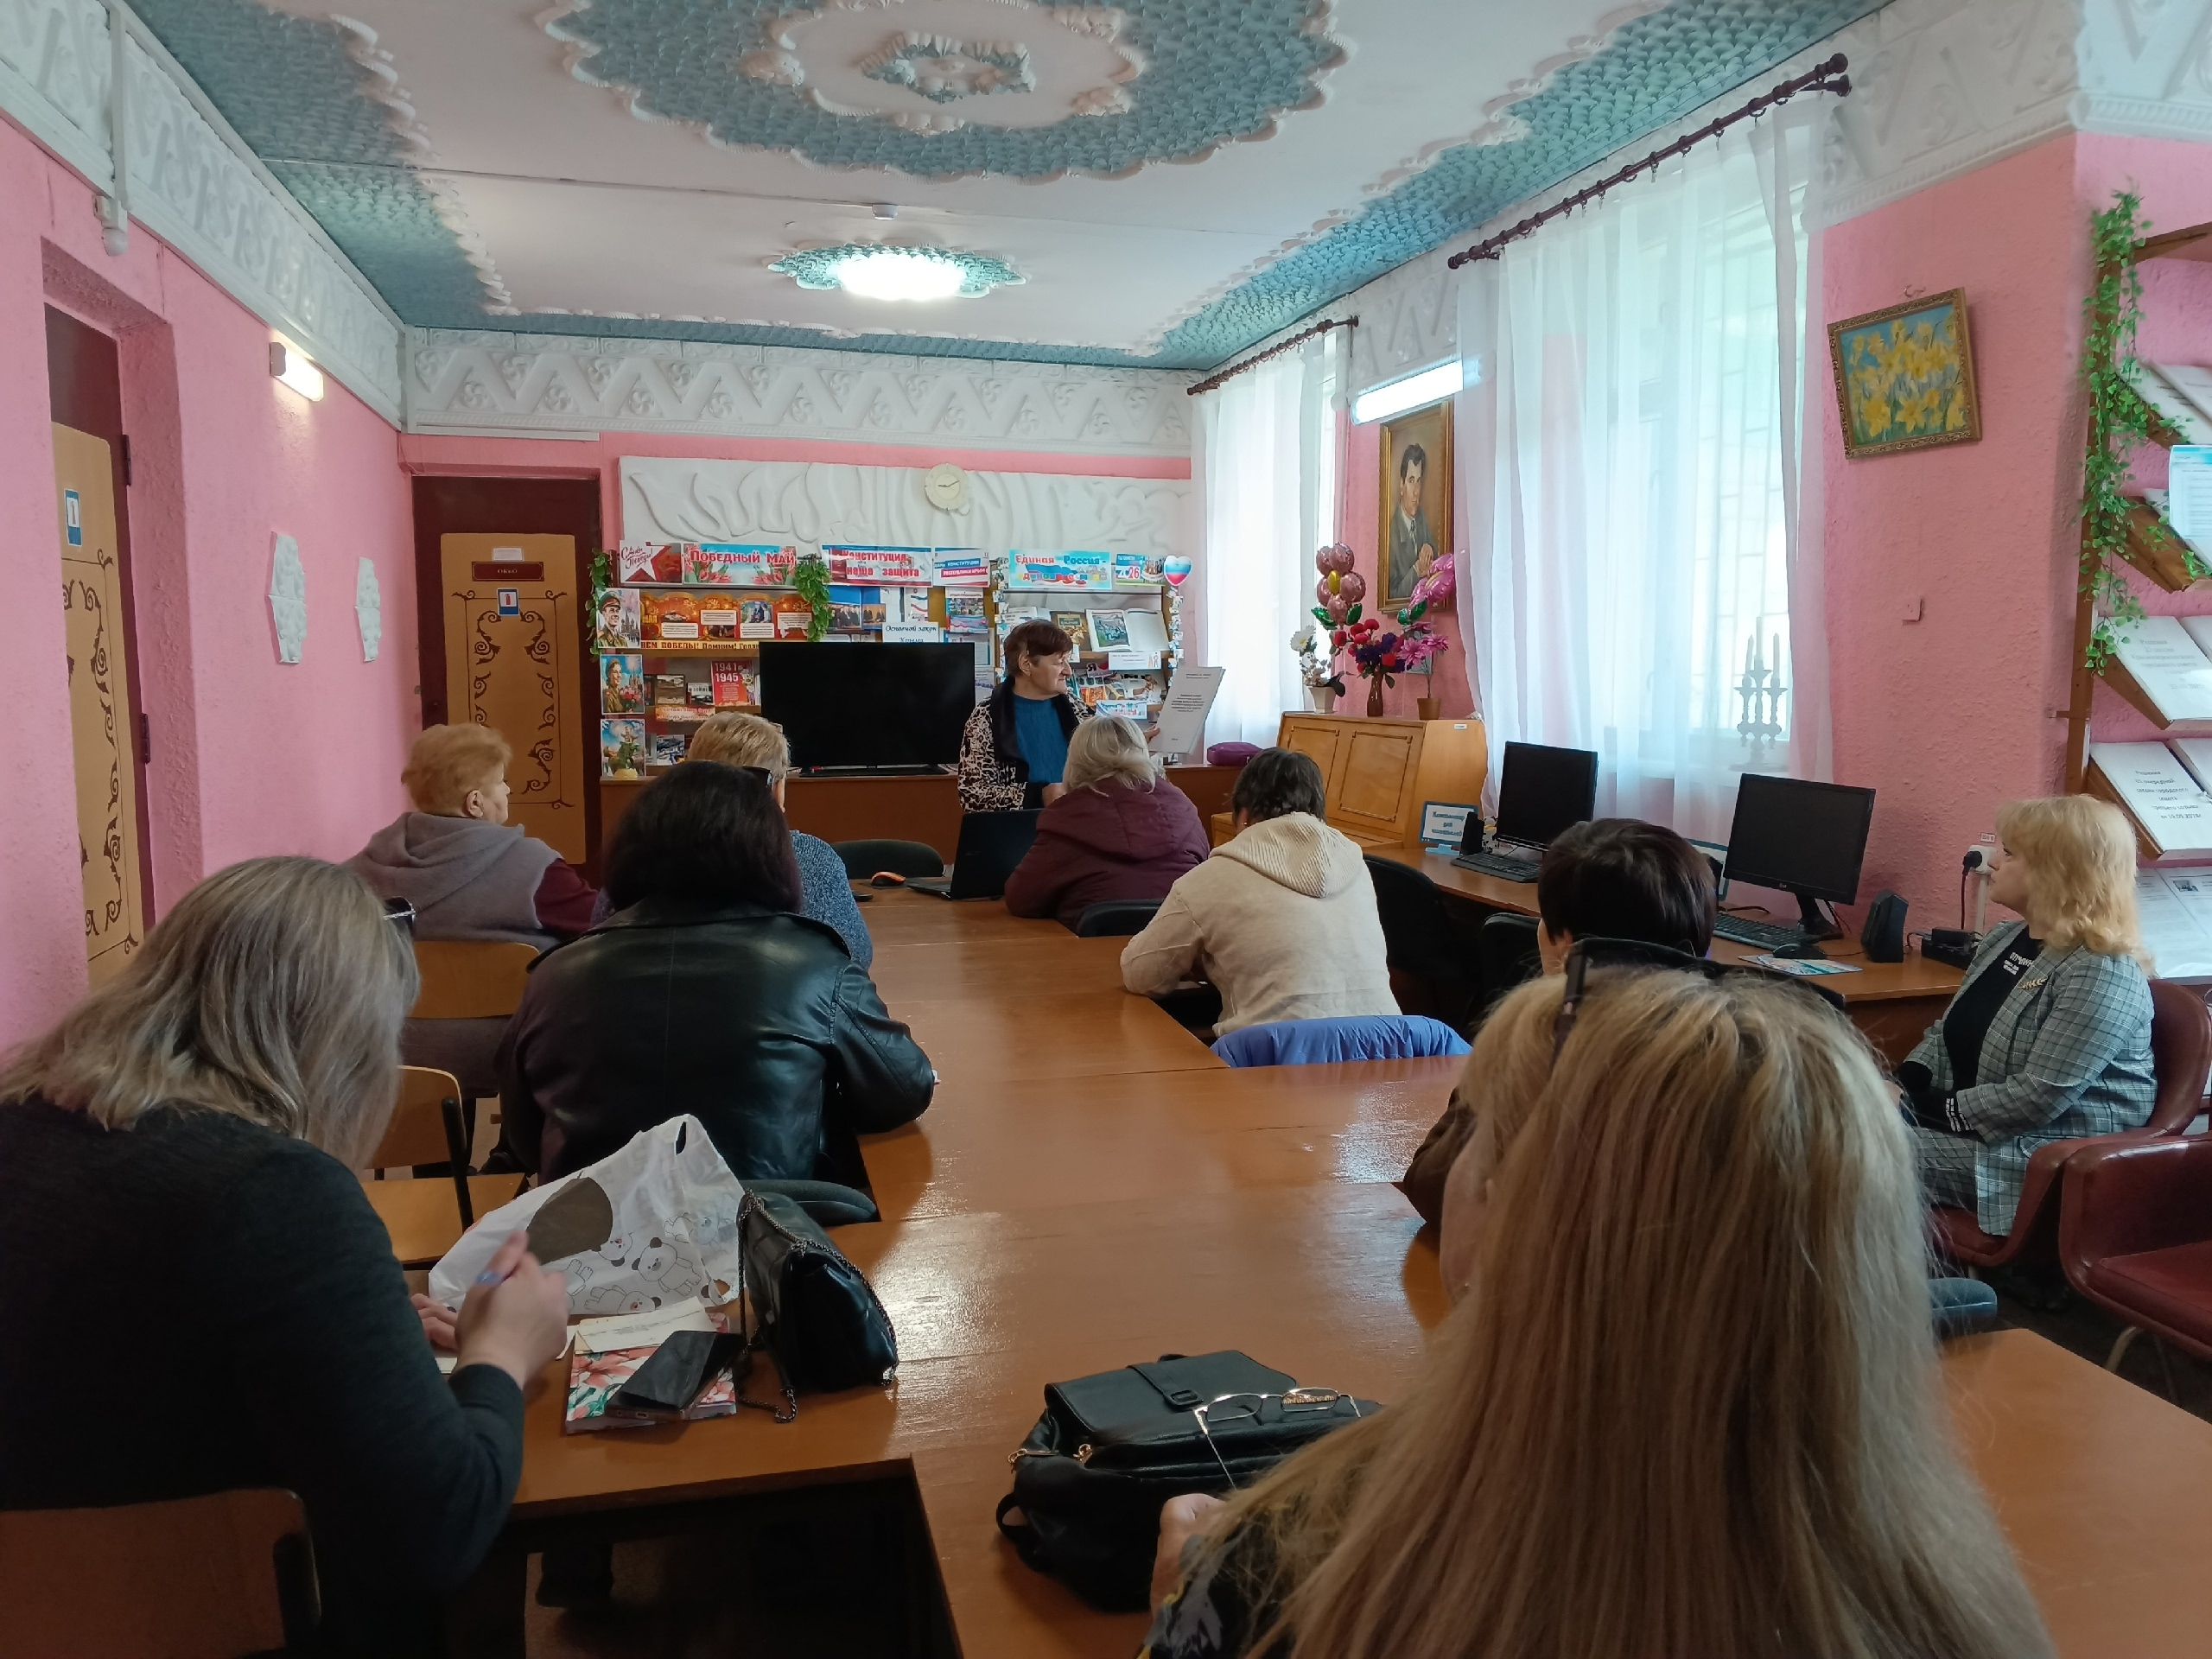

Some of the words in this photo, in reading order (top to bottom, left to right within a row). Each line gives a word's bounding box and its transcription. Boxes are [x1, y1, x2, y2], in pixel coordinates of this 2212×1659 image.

[691, 550, 760, 564] ПОБЕДНЫЙ
[766, 551, 794, 564] МАЙ
[1015, 555, 1054, 564] Единая
[1064, 555, 1100, 565] Россия
[847, 567, 874, 575] наша
[882, 568, 919, 577] защита
[715, 662, 737, 671] 1941
[715, 672, 739, 682] 1945
